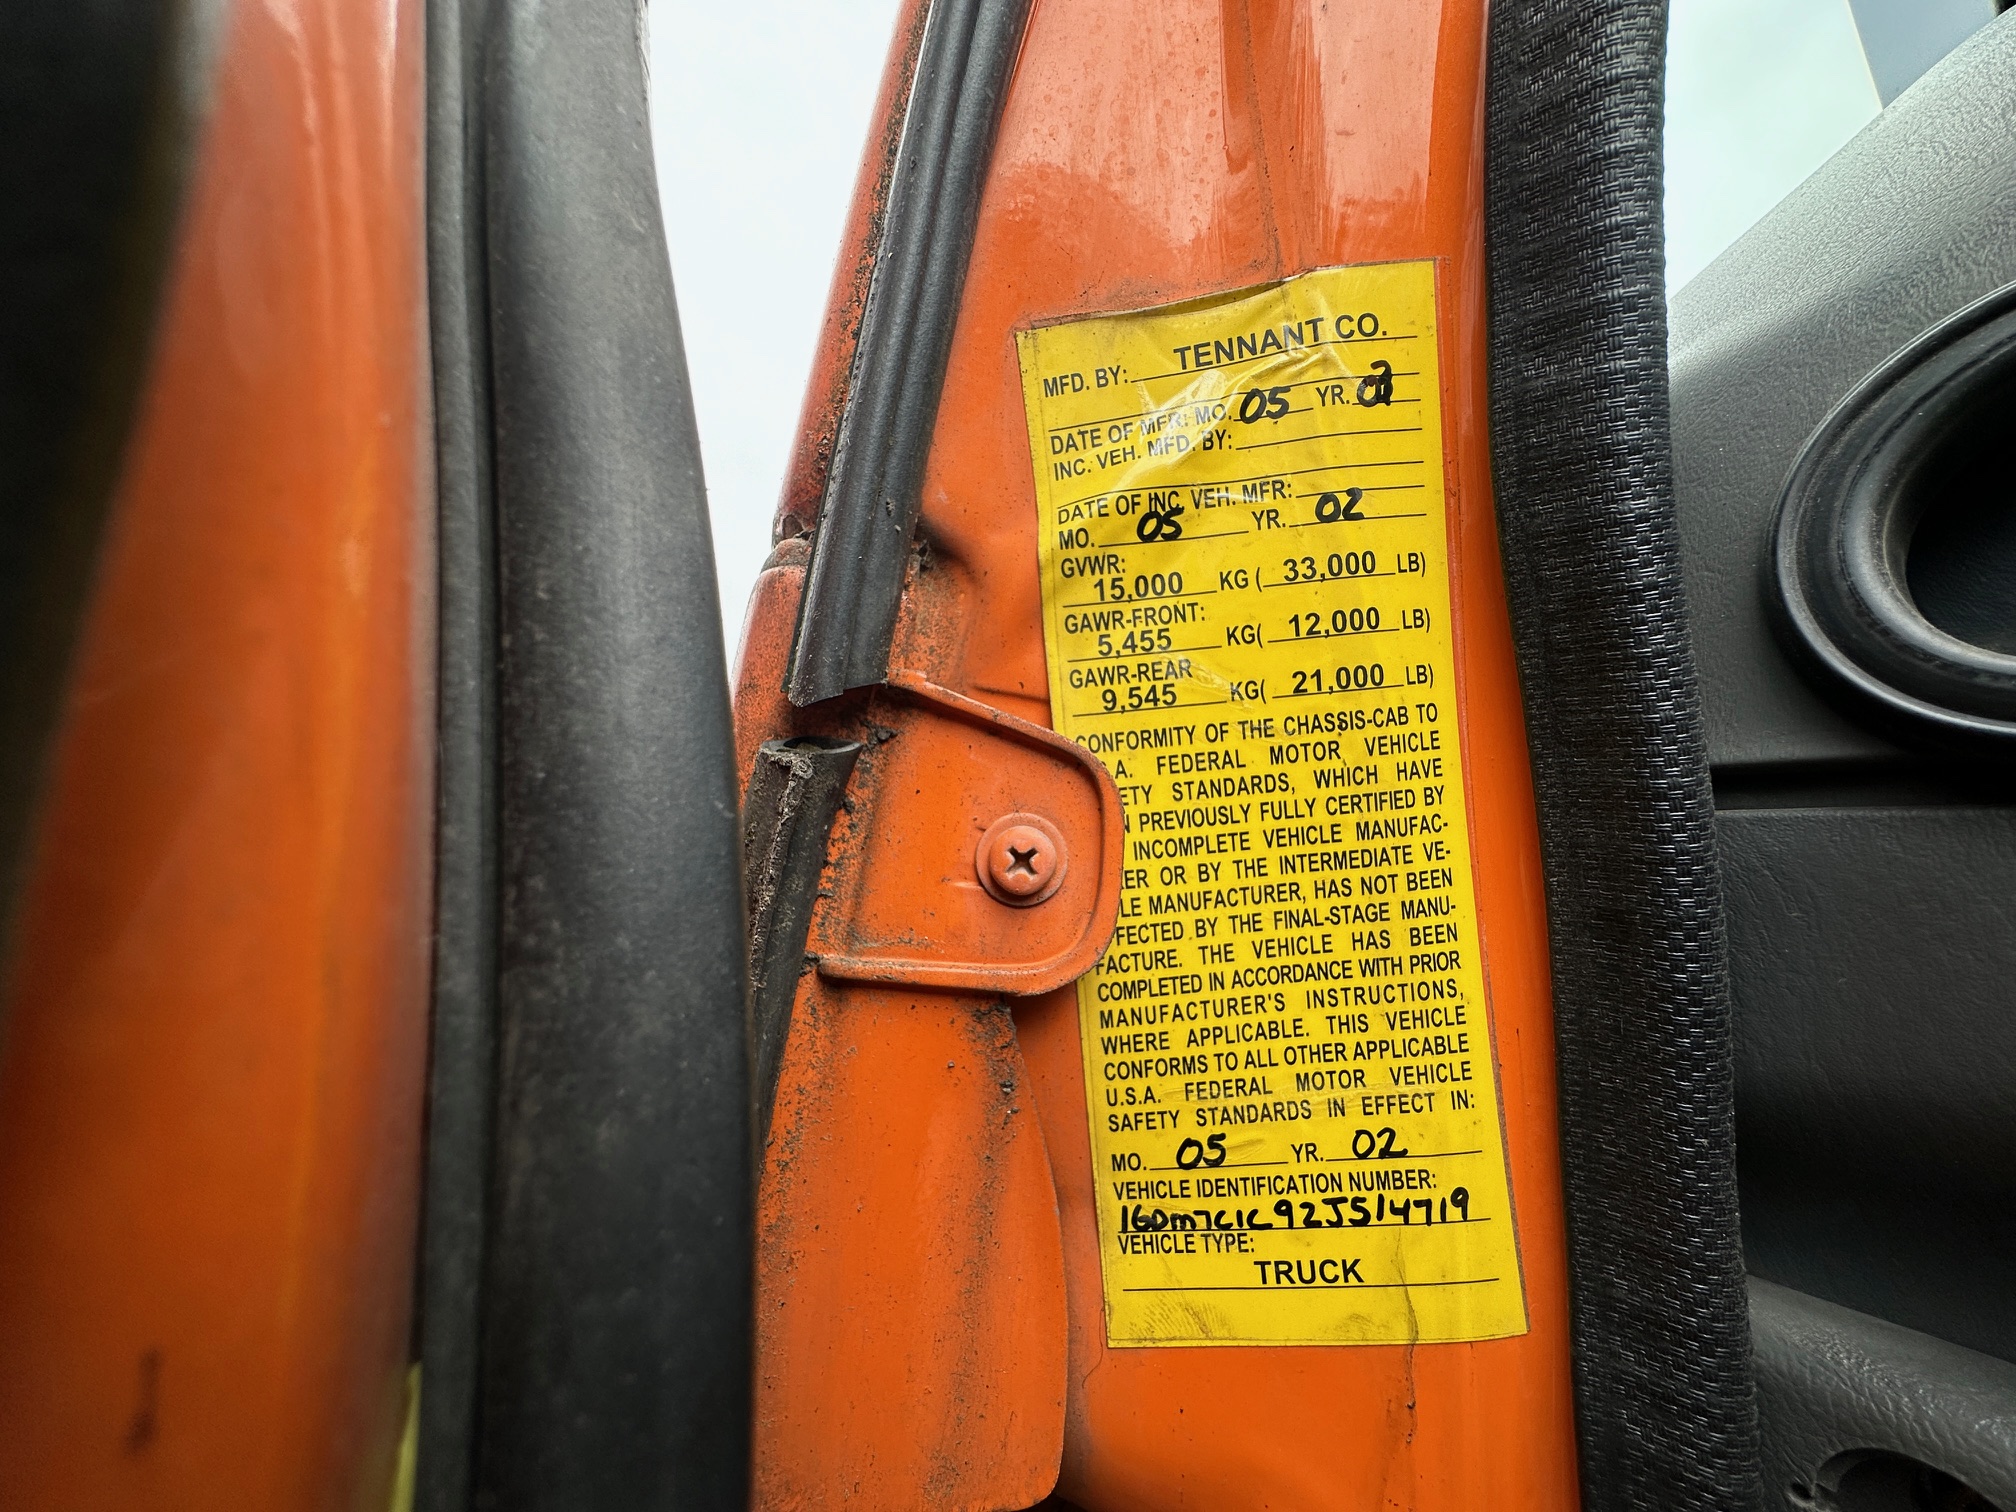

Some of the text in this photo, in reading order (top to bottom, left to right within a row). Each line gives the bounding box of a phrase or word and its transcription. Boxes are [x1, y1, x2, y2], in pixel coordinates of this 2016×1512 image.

[1044, 312, 1387, 398] MFD. BY: TENNANT CO.
[1051, 422, 1101, 455] DATE
[1108, 415, 1133, 443] OF
[1197, 401, 1233, 424] MO.
[1239, 387, 1290, 424] 05
[1317, 386, 1349, 407] YR.
[1054, 429, 1231, 481] INC. VEH. MFD. BY:
[1058, 492, 1109, 525] DATE
[1115, 494, 1141, 516] OF
[1190, 487, 1236, 509] VEH.
[1242, 480, 1292, 504] MFR:
[1059, 487, 1365, 550] MO. 05 YR. 02
[1061, 554, 1125, 578] GVWR:
[1093, 572, 1183, 604] 15,000
[1282, 551, 1376, 584] 33,000
[1397, 552, 1425, 574] LB)
[1065, 602, 1205, 634] GAWR-FRONT:
[1098, 628, 1172, 657] 5,455
[1288, 607, 1380, 638] 12,000
[1402, 608, 1430, 630] LB)
[1070, 659, 1193, 689] GAWR-REAR
[1102, 683, 1177, 712] 9,545
[1291, 664, 1384, 697] 21,000
[1405, 663, 1433, 687] LB)
[1205, 722, 1229, 743] OF
[1238, 718, 1275, 740] THE
[1284, 706, 1408, 736] CHASSIS-CAB
[1416, 703, 1437, 723] TO
[1157, 749, 1246, 775] FEDERAL
[1270, 740, 1341, 765] MOTOR
[1364, 730, 1440, 756] VEHICLE
[1120, 758, 1443, 807] ETY STANDARDS, WHICH HAVE
[1139, 803, 1251, 832] PREVIOUSLY
[1260, 798, 1316, 821] FULLY
[1326, 789, 1415, 816] CERTIFIED
[1424, 785, 1444, 806] BY
[1134, 813, 1448, 860] INCOMPLETE VEHICLE MANUFAC-
[1160, 862, 1187, 886] OR
[1198, 859, 1221, 882] BY
[1232, 857, 1268, 879] THE
[1279, 845, 1413, 875] INTERMEDIATE
[1423, 841, 1450, 861] VE-
[1149, 883, 1306, 915] MANUFACTURER,
[1314, 878, 1352, 899] HAS
[1361, 874, 1398, 895] NOT
[1406, 867, 1452, 891] BEEN
[1115, 895, 1456, 946] FECTED BY THE FINAL-STAGE MANU-
[1198, 943, 1235, 965] THE
[1251, 934, 1333, 959] VEHICLE
[1352, 930, 1390, 951] HAS
[1410, 922, 1458, 946] BEEN
[1098, 950, 1461, 1002] COMPLETED IN ACCORDANCE WITH PRIOR
[1100, 978, 1463, 1029] MANUFACTURER'S INSTRUCTIONS,
[1101, 1005, 1466, 1055] WHERE APPLICABLE. THIS VEHICLE
[1104, 1033, 1469, 1081] CONFORMS TO ALL OTHER APPLICABLE
[1106, 1061, 1472, 1107] U.S.A. FEDERAL MOTOR VEHICLE
[1108, 1089, 1474, 1132] SAFETY STANDARDS IN EFFECT IN:
[1111, 1127, 1408, 1171] MO. 05 YR. 02
[1113, 1169, 1436, 1200] VEHICLE IDENTIFICATION NUMBER:
[1117, 1230, 1254, 1254] VEHICLE TYPE:
[1254, 1259, 1364, 1284] TRUCK
